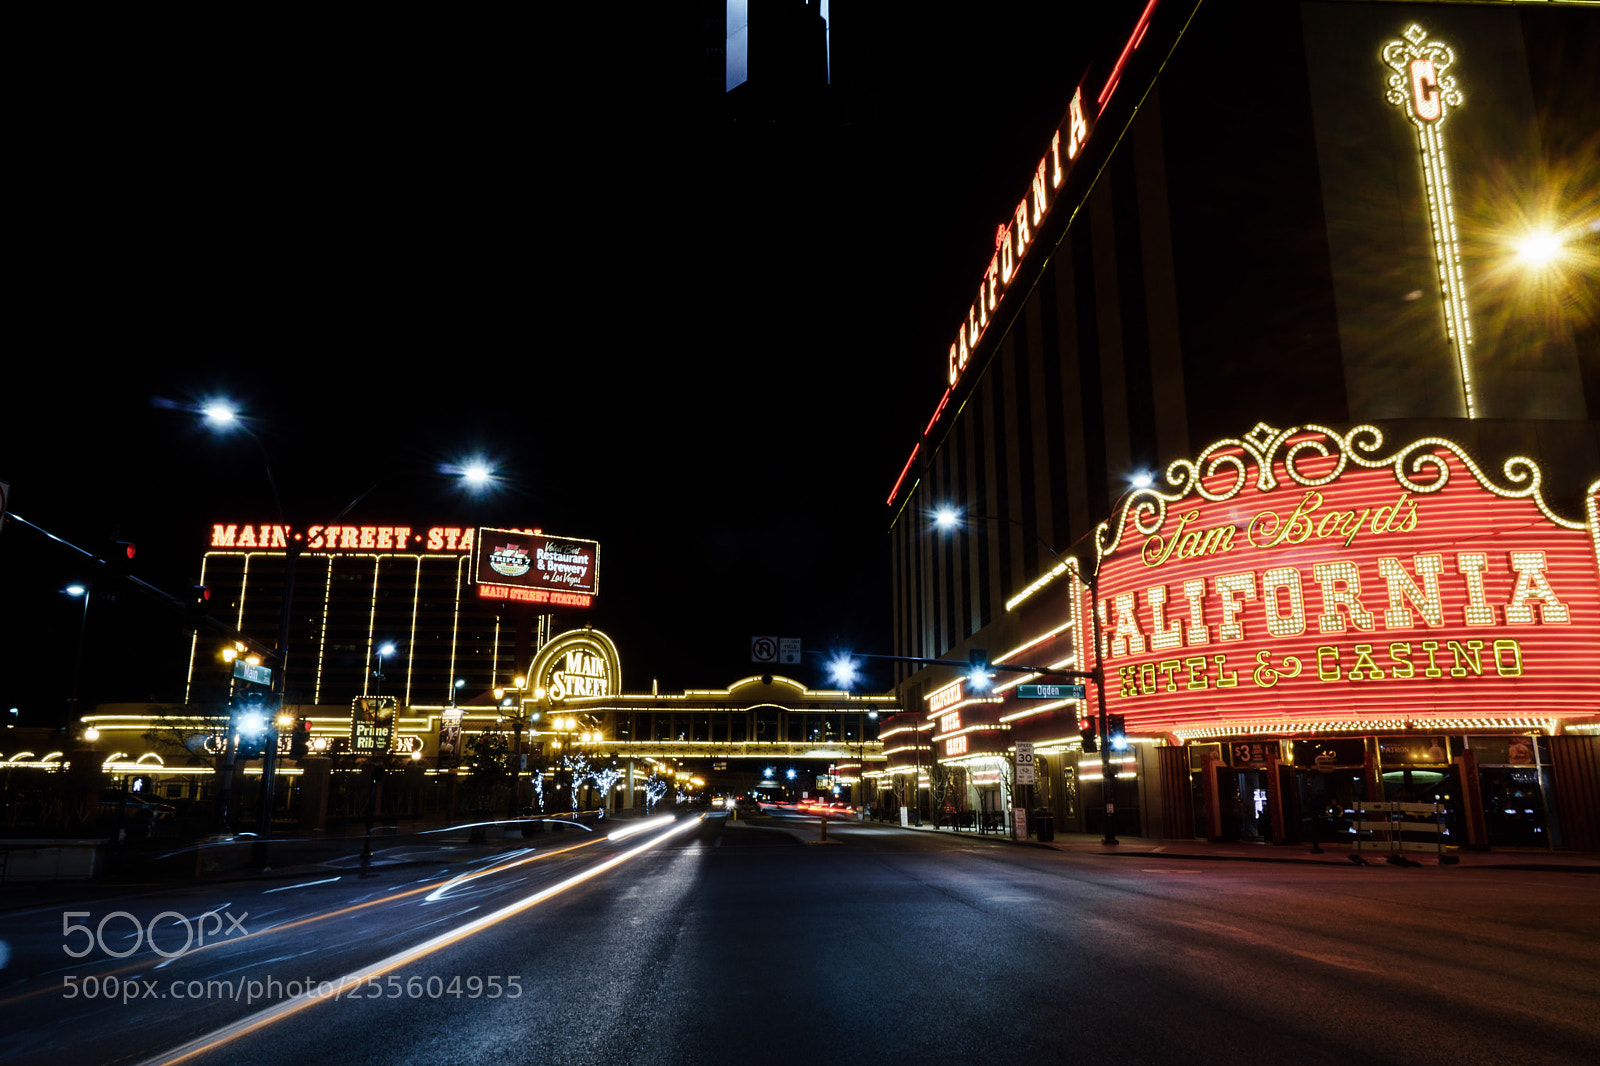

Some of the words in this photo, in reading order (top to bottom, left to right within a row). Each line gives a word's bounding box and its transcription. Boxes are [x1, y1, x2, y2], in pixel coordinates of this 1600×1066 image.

[1410, 59, 1441, 121] C
[948, 86, 1087, 386] CALIFORNIA
[211, 525, 290, 547] MAIN
[308, 526, 411, 549] STREET
[1142, 510, 1236, 568] Sam
[1247, 490, 1418, 548] Boyd's
[489, 554, 523, 565] TRIPLE
[536, 548, 589, 565] Restaurant
[537, 559, 546, 571] &
[547, 561, 587, 578] Brewery
[543, 572, 550, 580] in
[550, 571, 562, 583] Las
[562, 572, 581, 587] Vegas
[480, 585, 508, 598] MAIN
[510, 588, 549, 603] STREET
[550, 592, 591, 606] STATION
[244, 664, 258, 681] Main
[565, 651, 604, 677] MAIN
[1119, 654, 1238, 697] HOTEL
[1253, 650, 1302, 688] &
[1316, 639, 1523, 682] CASINO
[549, 670, 607, 700] STREET
[1037, 685, 1060, 698] Ogden
[356, 724, 389, 737] Prime
[356, 737, 375, 749] Rib
[1019, 754, 1032, 762] 30
[1235, 744, 1251, 762] $3
